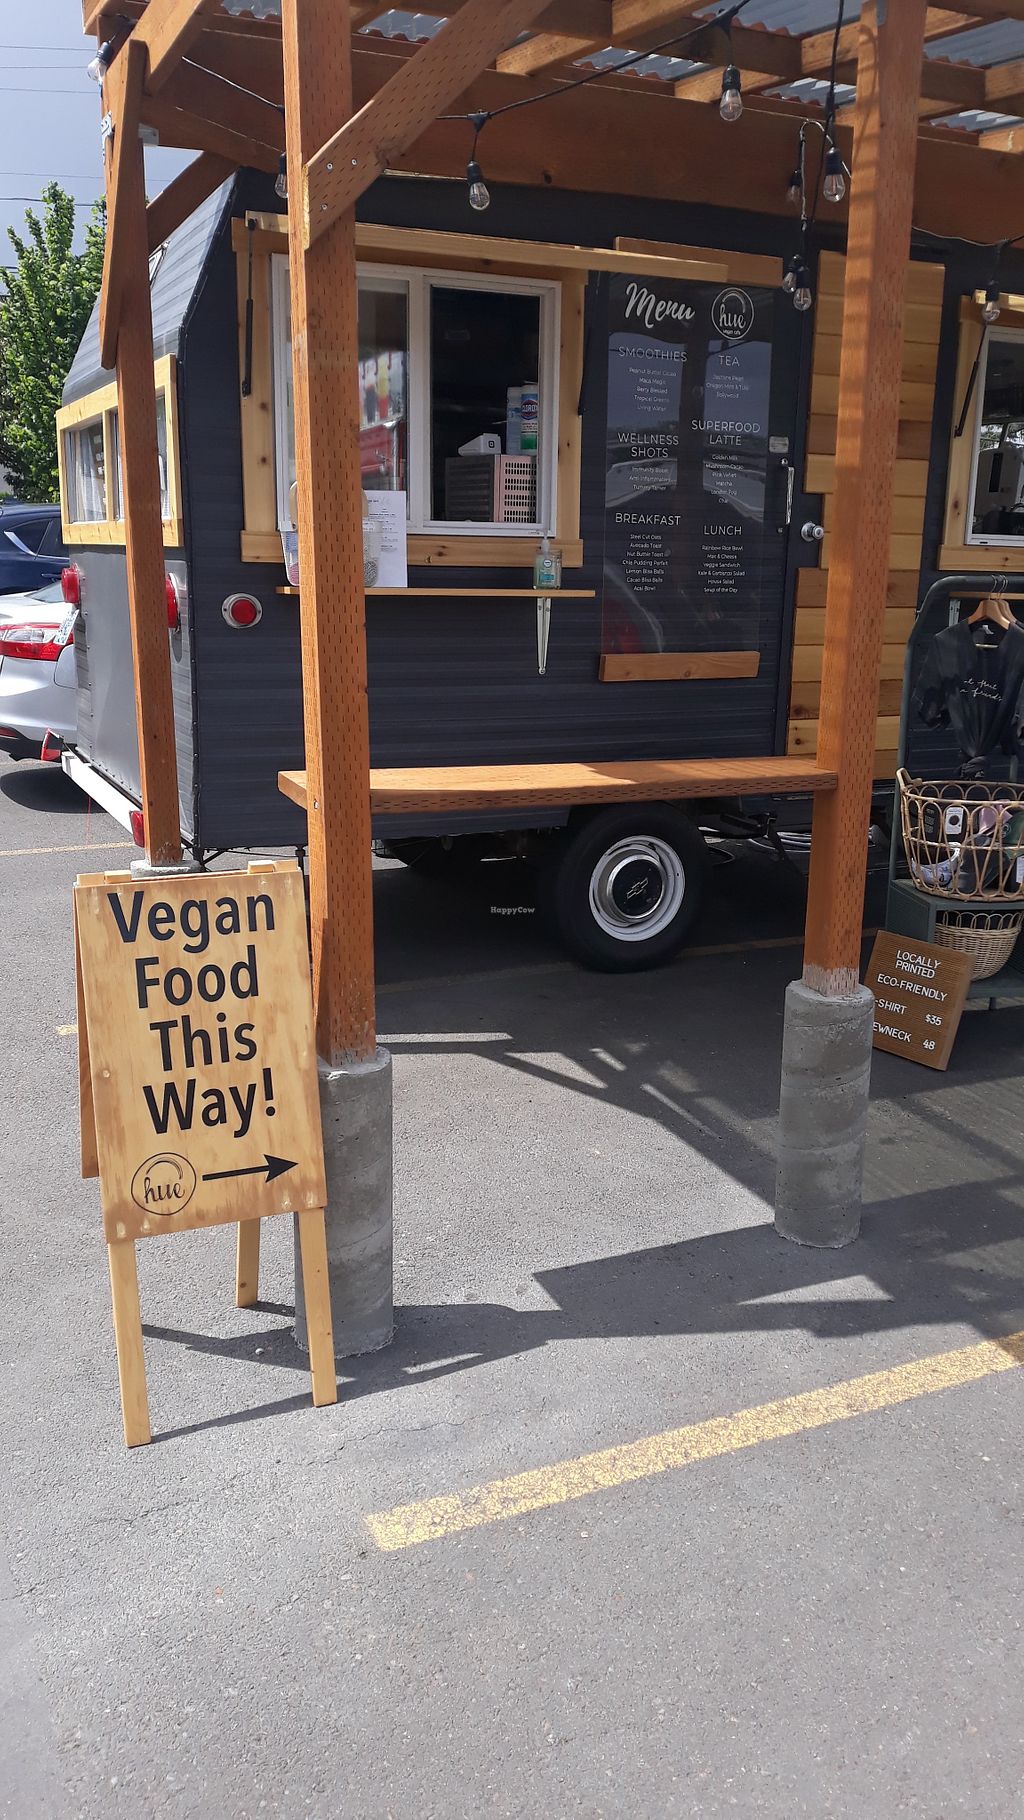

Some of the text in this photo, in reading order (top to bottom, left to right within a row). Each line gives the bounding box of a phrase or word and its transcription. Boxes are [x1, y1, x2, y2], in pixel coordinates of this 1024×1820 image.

[625, 283, 695, 328] Menu
[719, 304, 746, 328] hue
[619, 347, 687, 362] SMOOTHIES
[718, 355, 740, 366] TEA
[692, 420, 760, 432] SUPERFOOD
[618, 433, 678, 445] WELLNESS
[710, 434, 741, 445] LATTE
[632, 447, 668, 457] SHOTS
[616, 513, 681, 525] BREAKFAST
[704, 525, 742, 535] LUNCH
[107, 890, 275, 953] Vegan
[896, 961, 935, 978] PRINTED
[897, 951, 941, 968] LOCALLY
[135, 945, 259, 1009] Food
[878, 974, 948, 1001] ECO-FRIENDLY
[875, 999, 942, 1026] -SHIRT $35
[150, 1012, 257, 1072] This
[873, 1022, 935, 1050] EWNECK 48
[143, 1068, 276, 1138] Way!
[144, 1177, 185, 1203] hue
